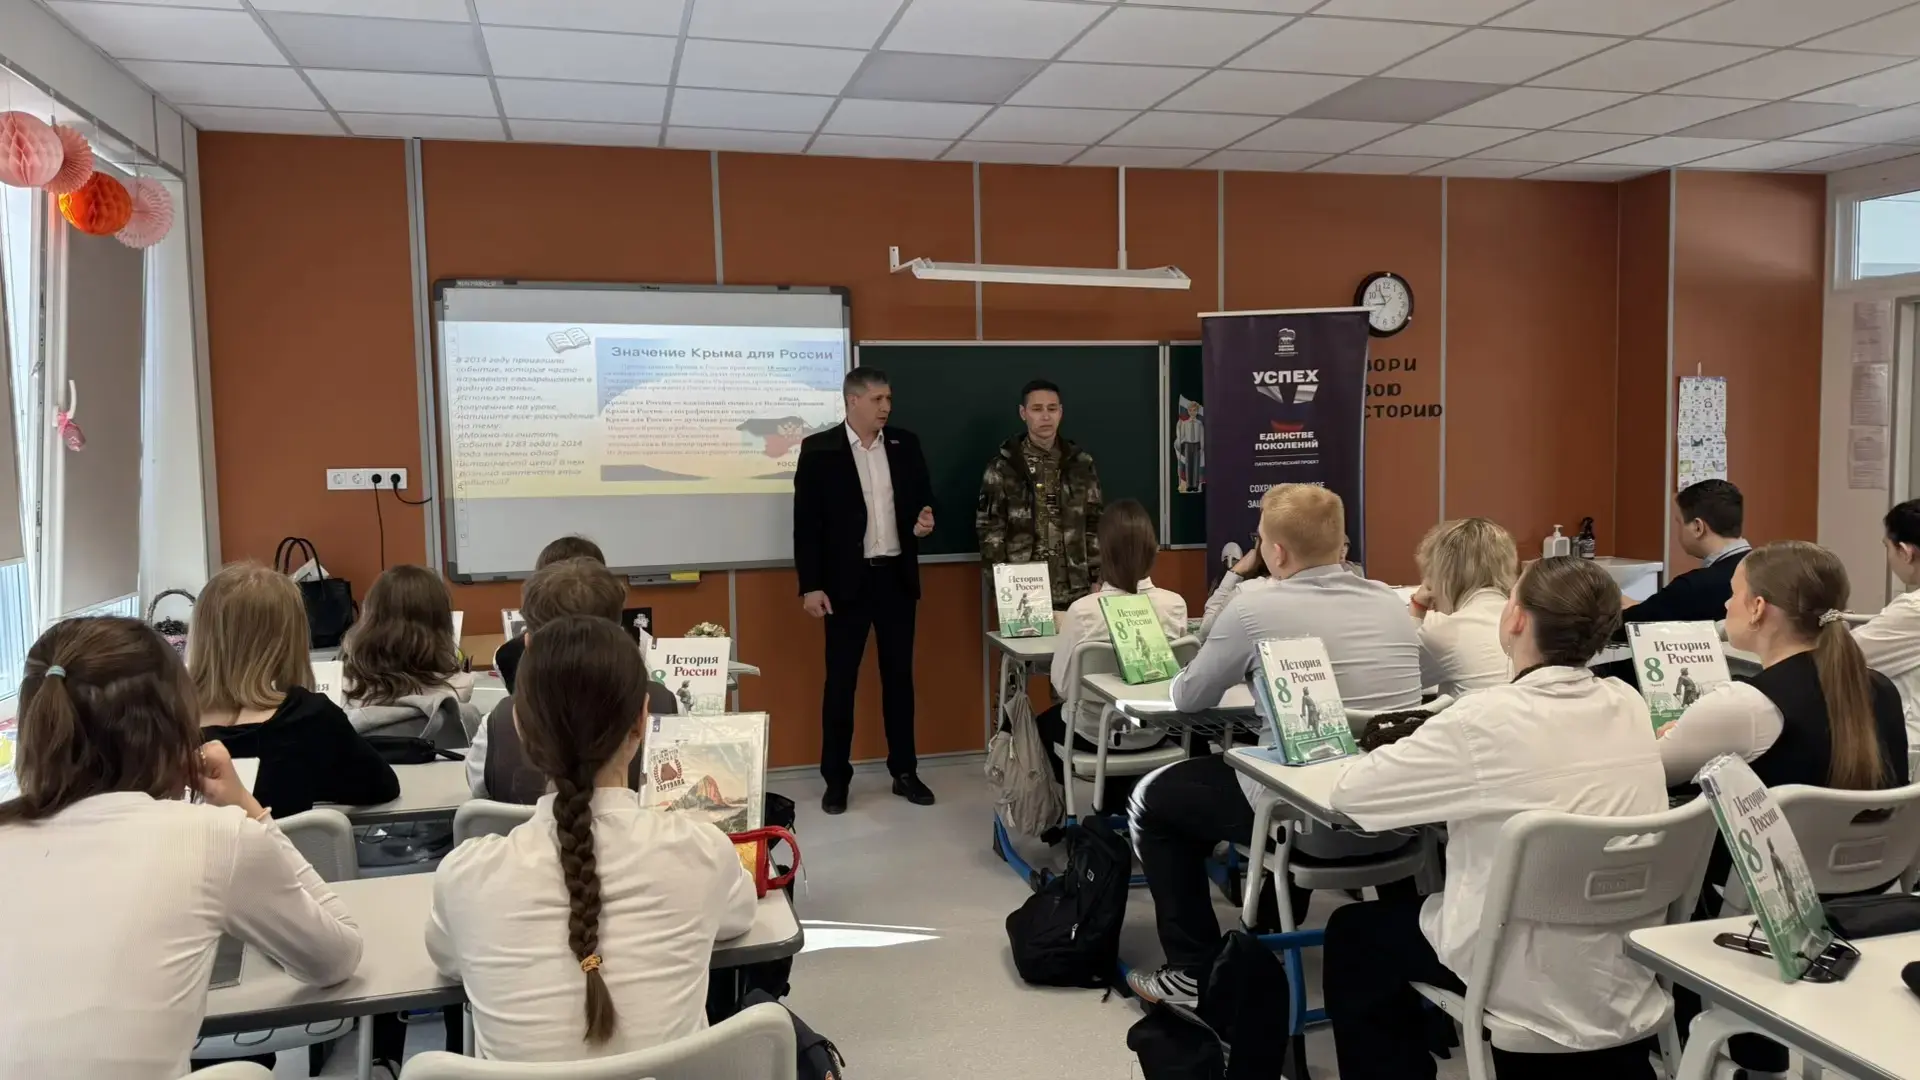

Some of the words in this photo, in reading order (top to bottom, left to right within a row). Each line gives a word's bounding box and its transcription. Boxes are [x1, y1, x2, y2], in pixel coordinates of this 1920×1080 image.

[611, 346, 686, 359] Значение
[691, 347, 743, 362] Крыма
[746, 349, 777, 363] для
[780, 350, 834, 362] России
[1367, 358, 1417, 372] ОРИ
[1252, 369, 1319, 385] УСПЕХ
[1364, 404, 1443, 419] СТОРИЮ
[1259, 431, 1315, 441] ЕДИНСТВЕ
[1254, 439, 1319, 451] ПОКОЛЕНИЙ
[1000, 586, 1012, 603] 8
[1117, 609, 1150, 618] История
[1126, 618, 1153, 626] России
[1115, 621, 1129, 641] 8
[1653, 640, 1711, 653] История
[665, 654, 719, 667] История
[1279, 658, 1323, 672] История
[1667, 653, 1715, 665] России
[673, 666, 717, 677] России
[1643, 657, 1665, 683] 8
[1290, 671, 1326, 684] России
[1274, 677, 1292, 703] 8
[656, 778, 685, 793] CAPYBARA
[1732, 787, 1768, 817] История
[1748, 808, 1780, 835] России
[1737, 829, 1764, 874] 8
